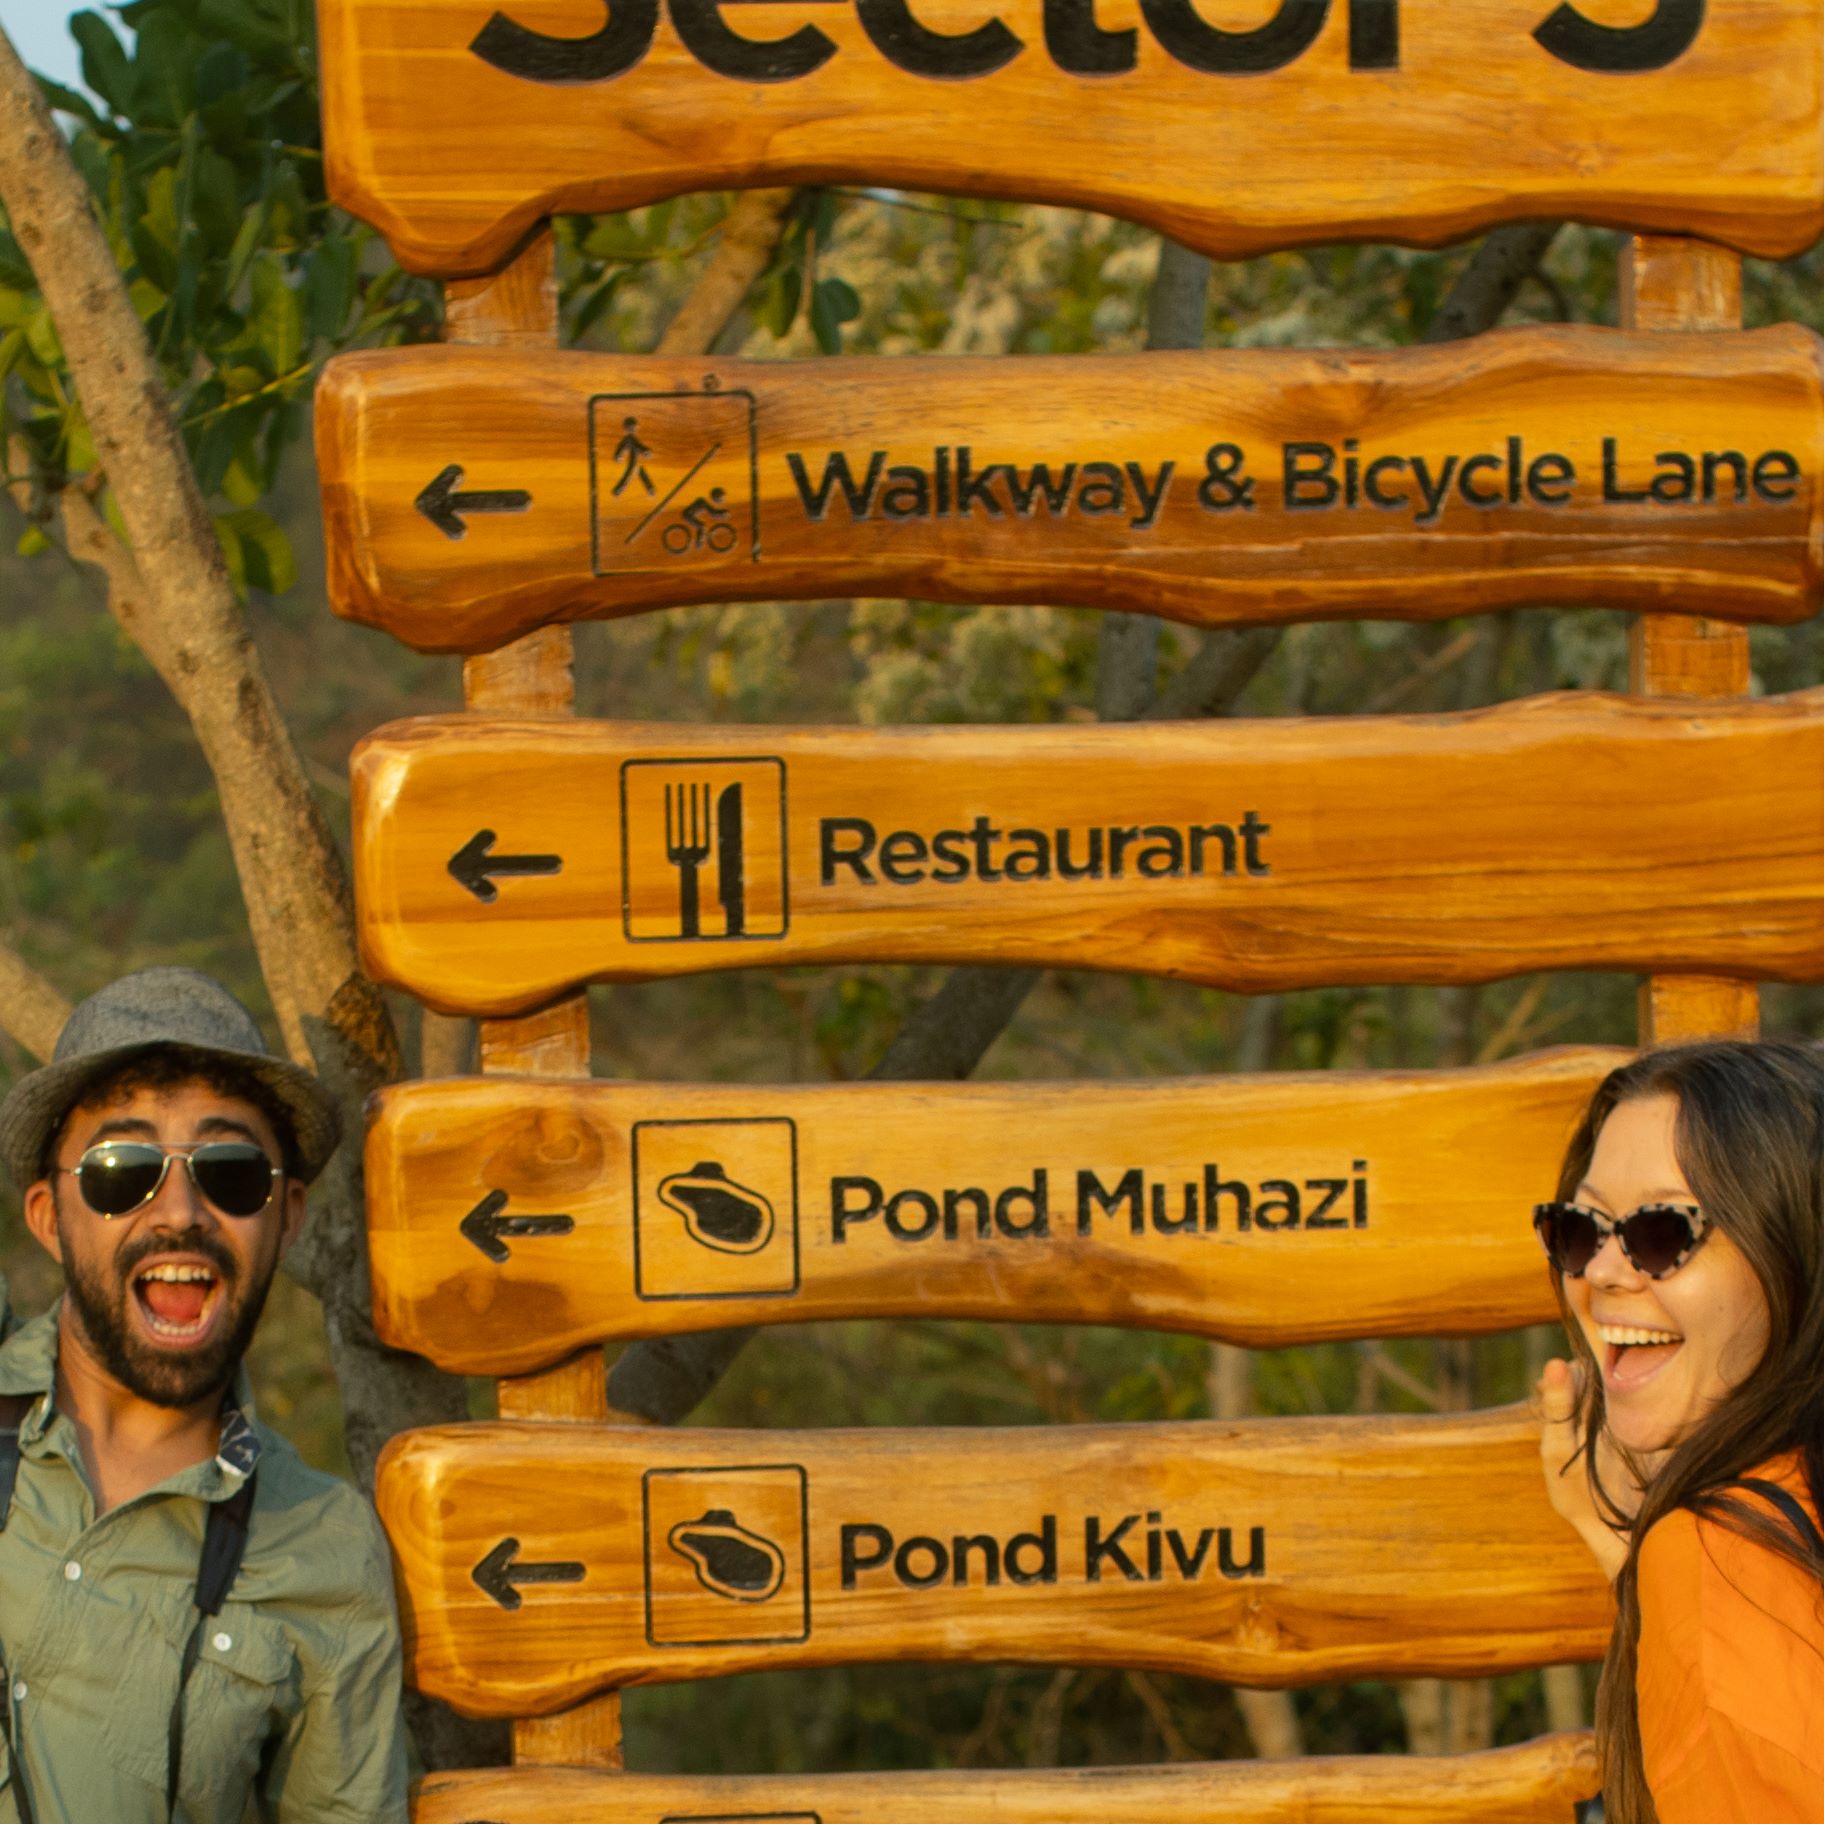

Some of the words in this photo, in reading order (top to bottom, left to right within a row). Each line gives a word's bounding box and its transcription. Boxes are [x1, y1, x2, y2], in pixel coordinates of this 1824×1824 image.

[786, 445, 1173, 529] Walkway
[1196, 442, 1257, 512] &
[1282, 436, 1577, 524] Bicycle
[1601, 436, 1802, 507] Lane
[819, 811, 1271, 886] Restaurant
[829, 1167, 1049, 1242] Pond
[1075, 1161, 1368, 1234] Muhazi
[839, 1513, 1059, 1588] Pond
[1083, 1513, 1267, 1582] Kivu
